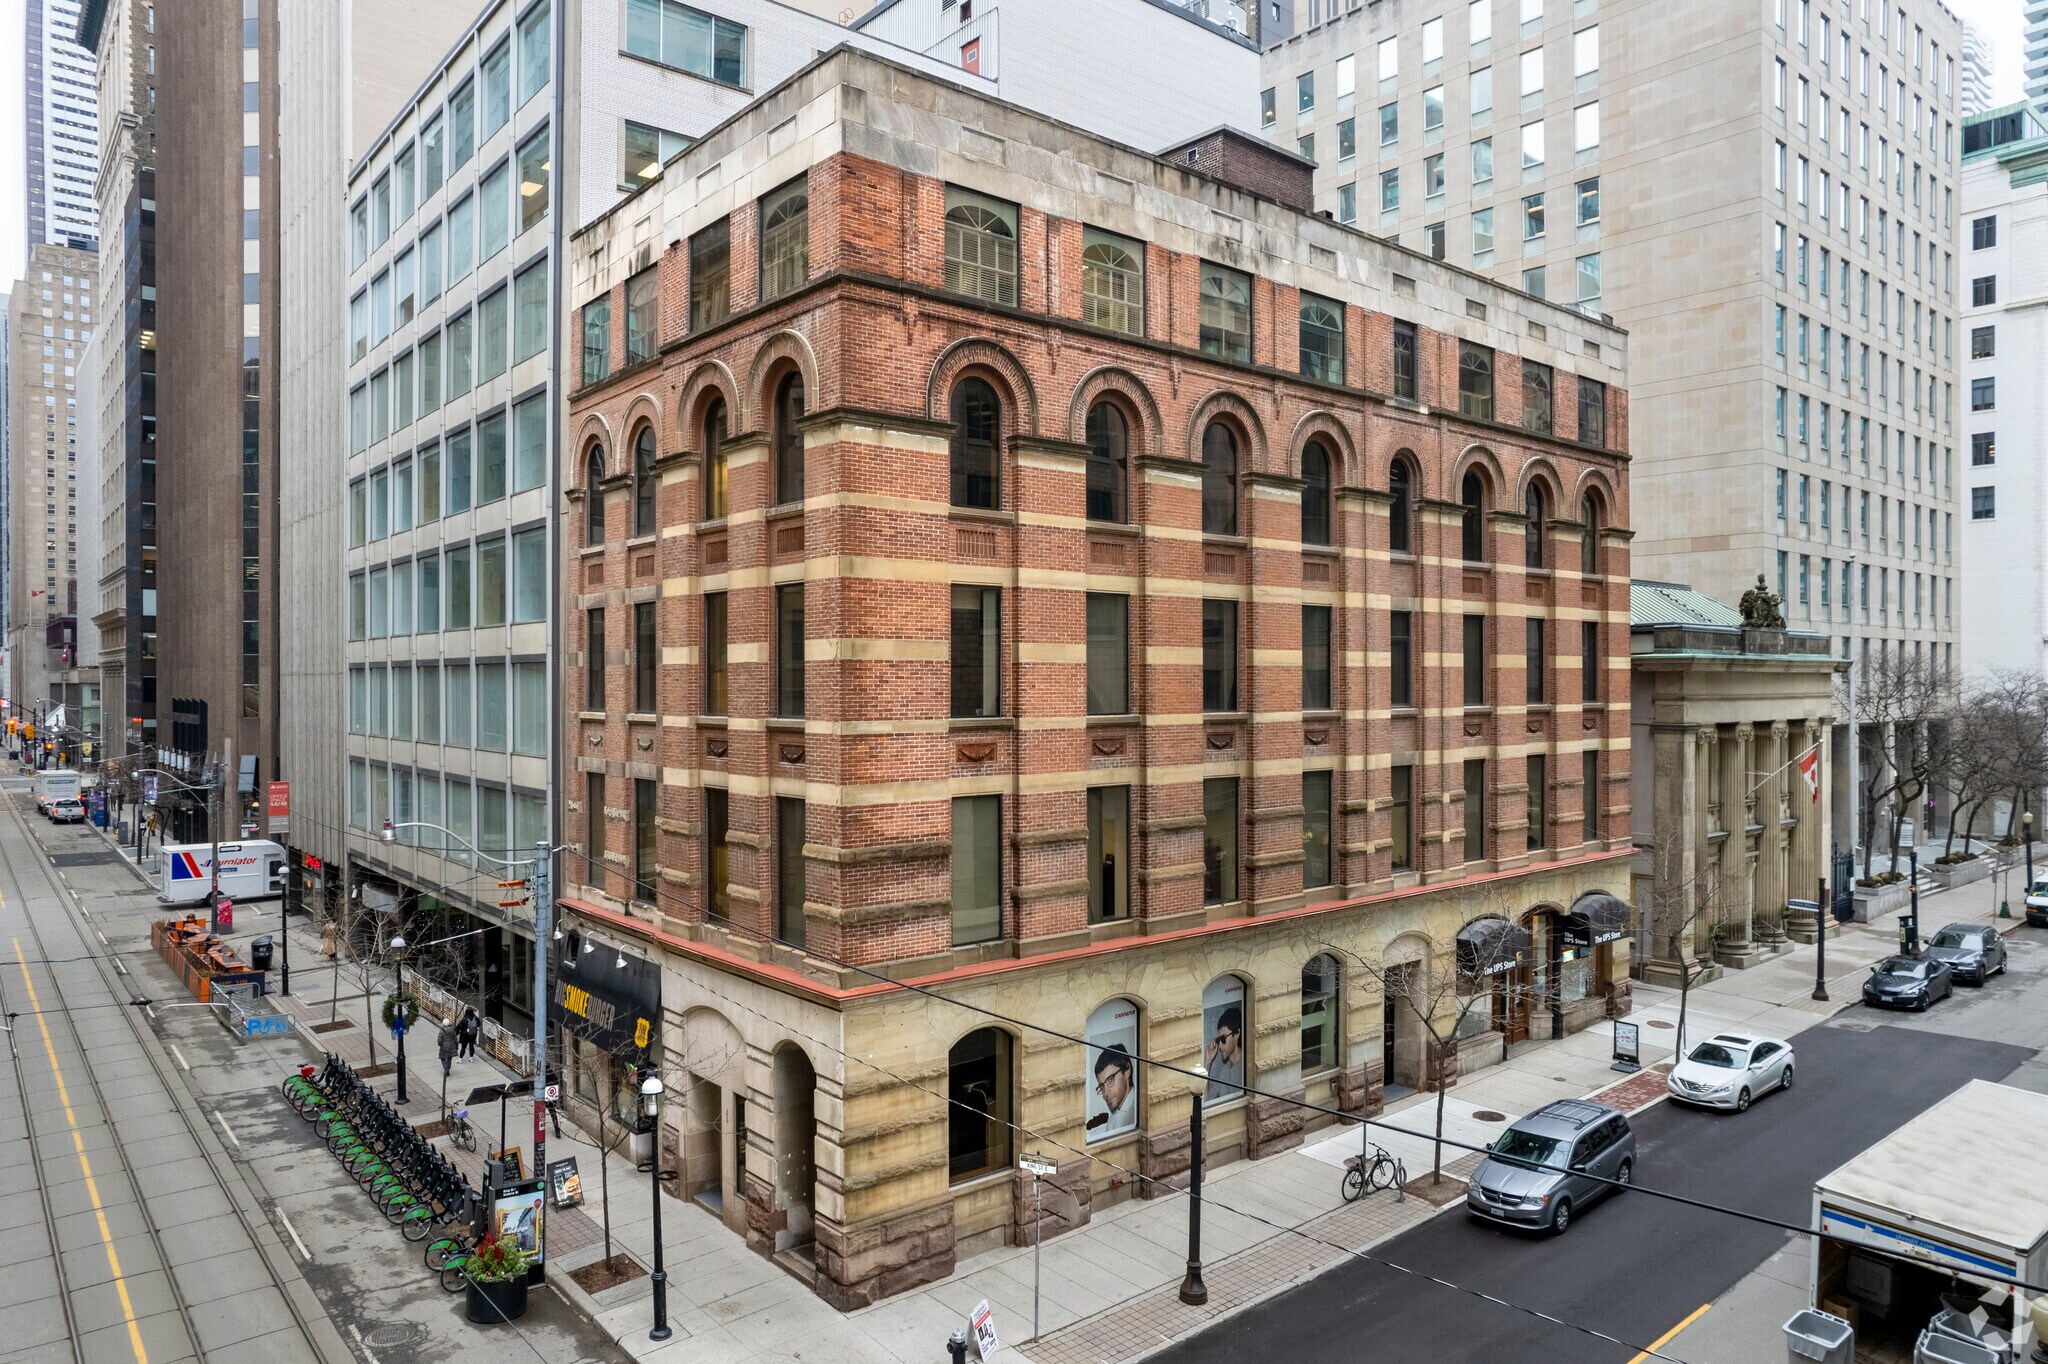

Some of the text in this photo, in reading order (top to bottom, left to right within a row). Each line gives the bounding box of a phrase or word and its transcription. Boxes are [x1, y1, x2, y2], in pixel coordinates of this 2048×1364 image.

[1595, 931, 1621, 944] The UPS Store
[1484, 966, 1493, 976] The
[1493, 962, 1504, 973] UPS
[1504, 960, 1516, 970] Store
[1114, 1009, 1136, 1019] CARRERA
